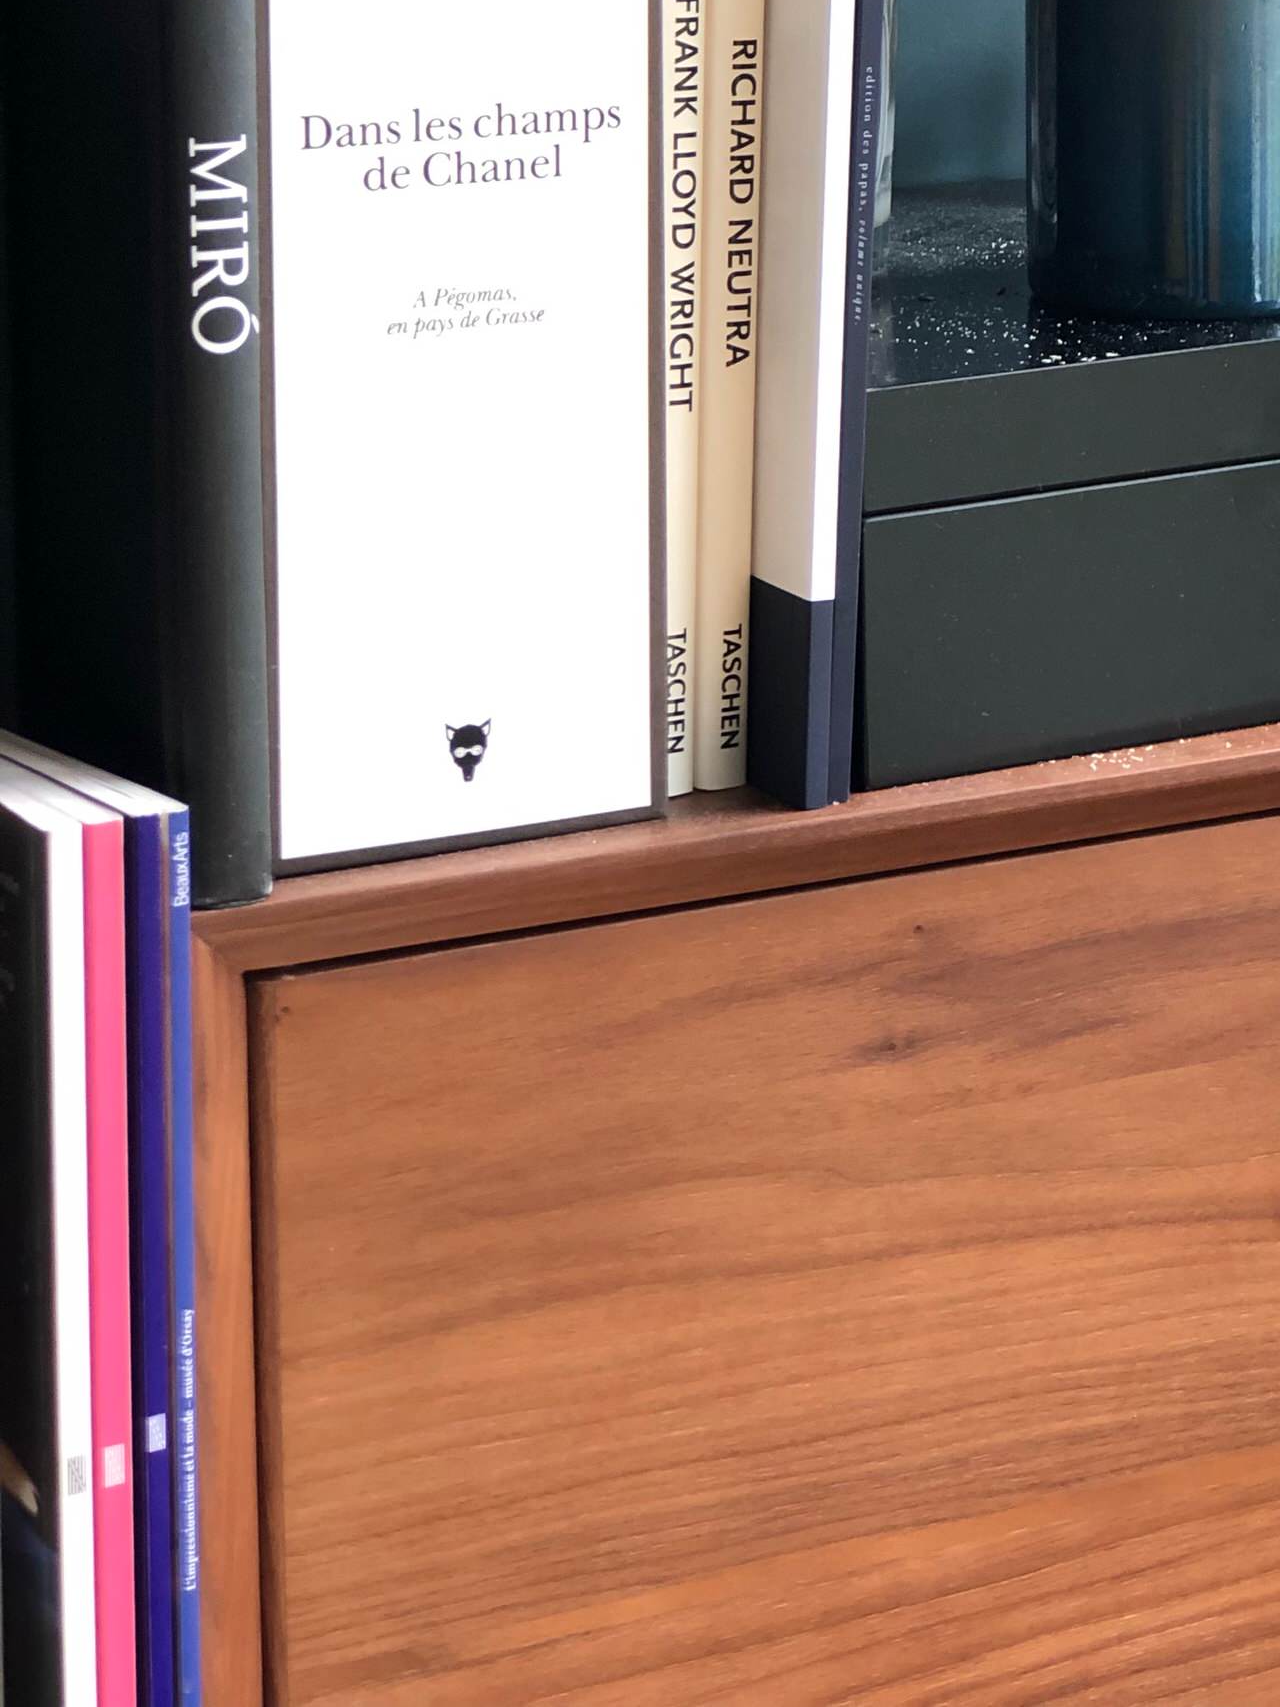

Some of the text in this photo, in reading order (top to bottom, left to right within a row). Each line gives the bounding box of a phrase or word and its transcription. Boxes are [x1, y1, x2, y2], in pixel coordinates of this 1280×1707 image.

[300, 103, 623, 150] Dans les champs
[362, 144, 562, 192] de Chanel
[862, 129, 873, 155] des
[188, 134, 259, 355] MIRÓ
[671, 131, 698, 250] LLOYD
[725, 38, 758, 368] RICHARD NEUTRA
[386, 307, 546, 339] en pays de Grasse
[412, 290, 427, 309] A
[667, 260, 696, 412] WRIGHT
[667, 628, 687, 754] TASCHEN
[720, 623, 743, 750] TASCHEN
